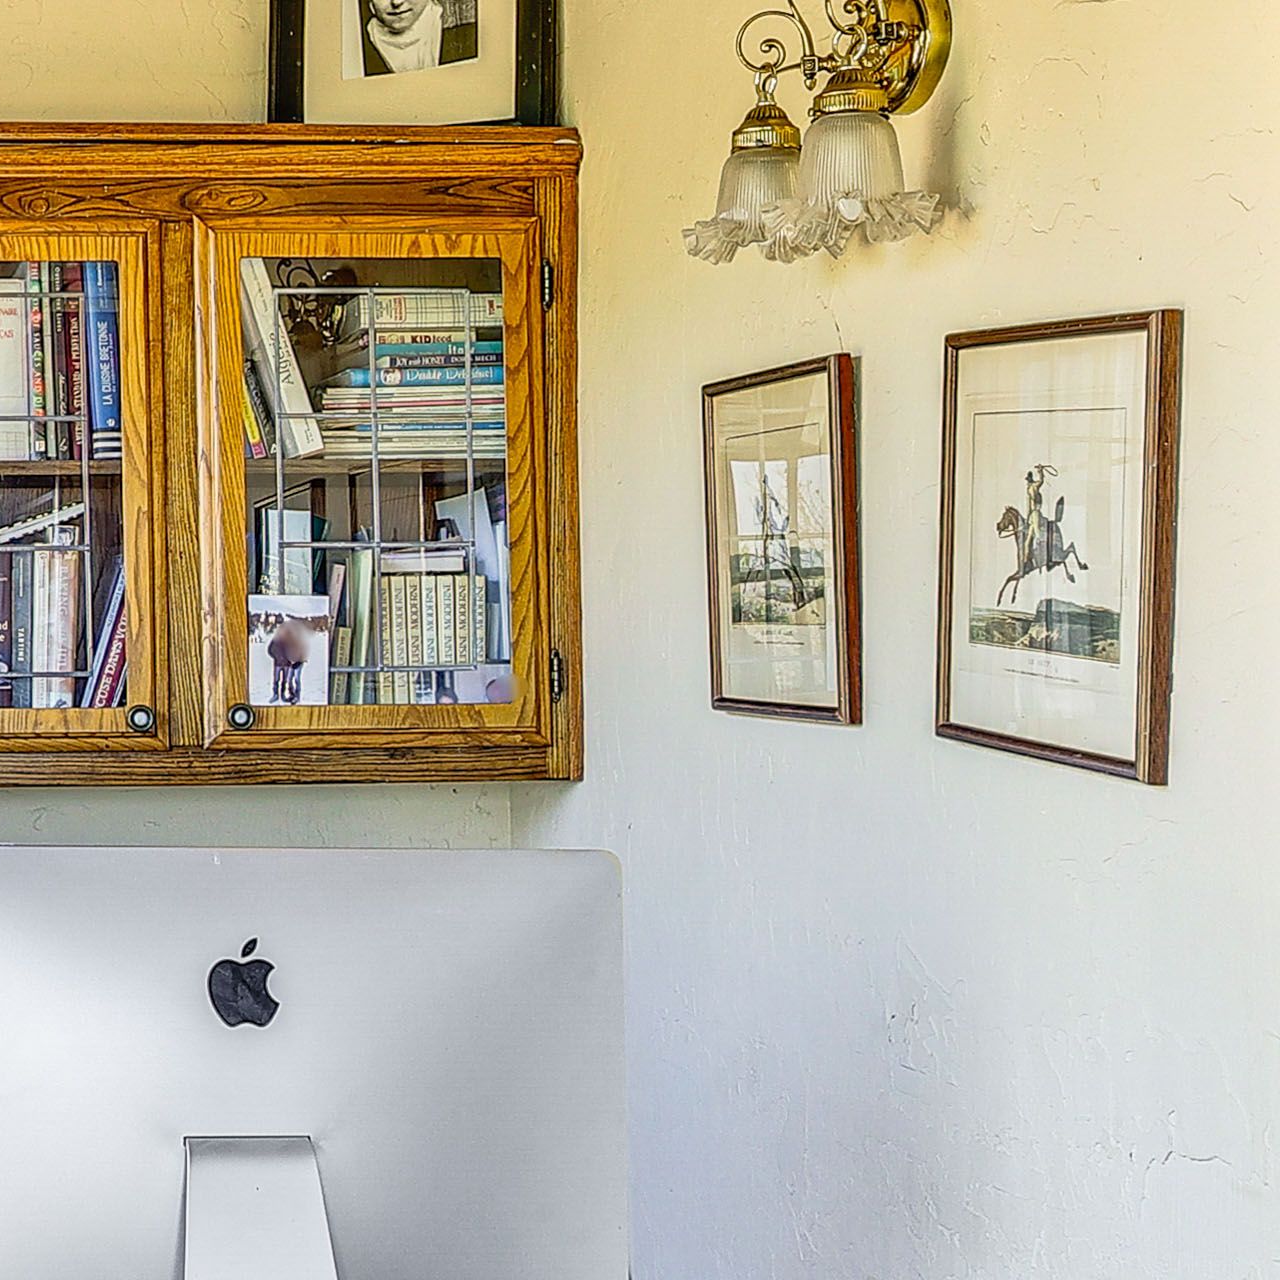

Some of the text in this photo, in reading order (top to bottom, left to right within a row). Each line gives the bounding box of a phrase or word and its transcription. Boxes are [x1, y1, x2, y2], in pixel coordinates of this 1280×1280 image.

[31, 281, 41, 312] BOK
[31, 314, 42, 329] OF
[32, 333, 42, 368] SAUCES
[97, 320, 109, 361] BRETONNE
[409, 334, 432, 345] KID
[99, 362, 112, 393] CUISINE
[421, 355, 446, 366] HONEY
[32, 372, 44, 394] AND
[102, 393, 114, 406] LA
[395, 588, 404, 632] MODERNE
[409, 584, 419, 630] MODERNE
[425, 587, 434, 632] MODERNE
[442, 584, 451, 630] MODERNE
[458, 584, 467, 631] MODERNE
[102, 639, 124, 678] DANS
